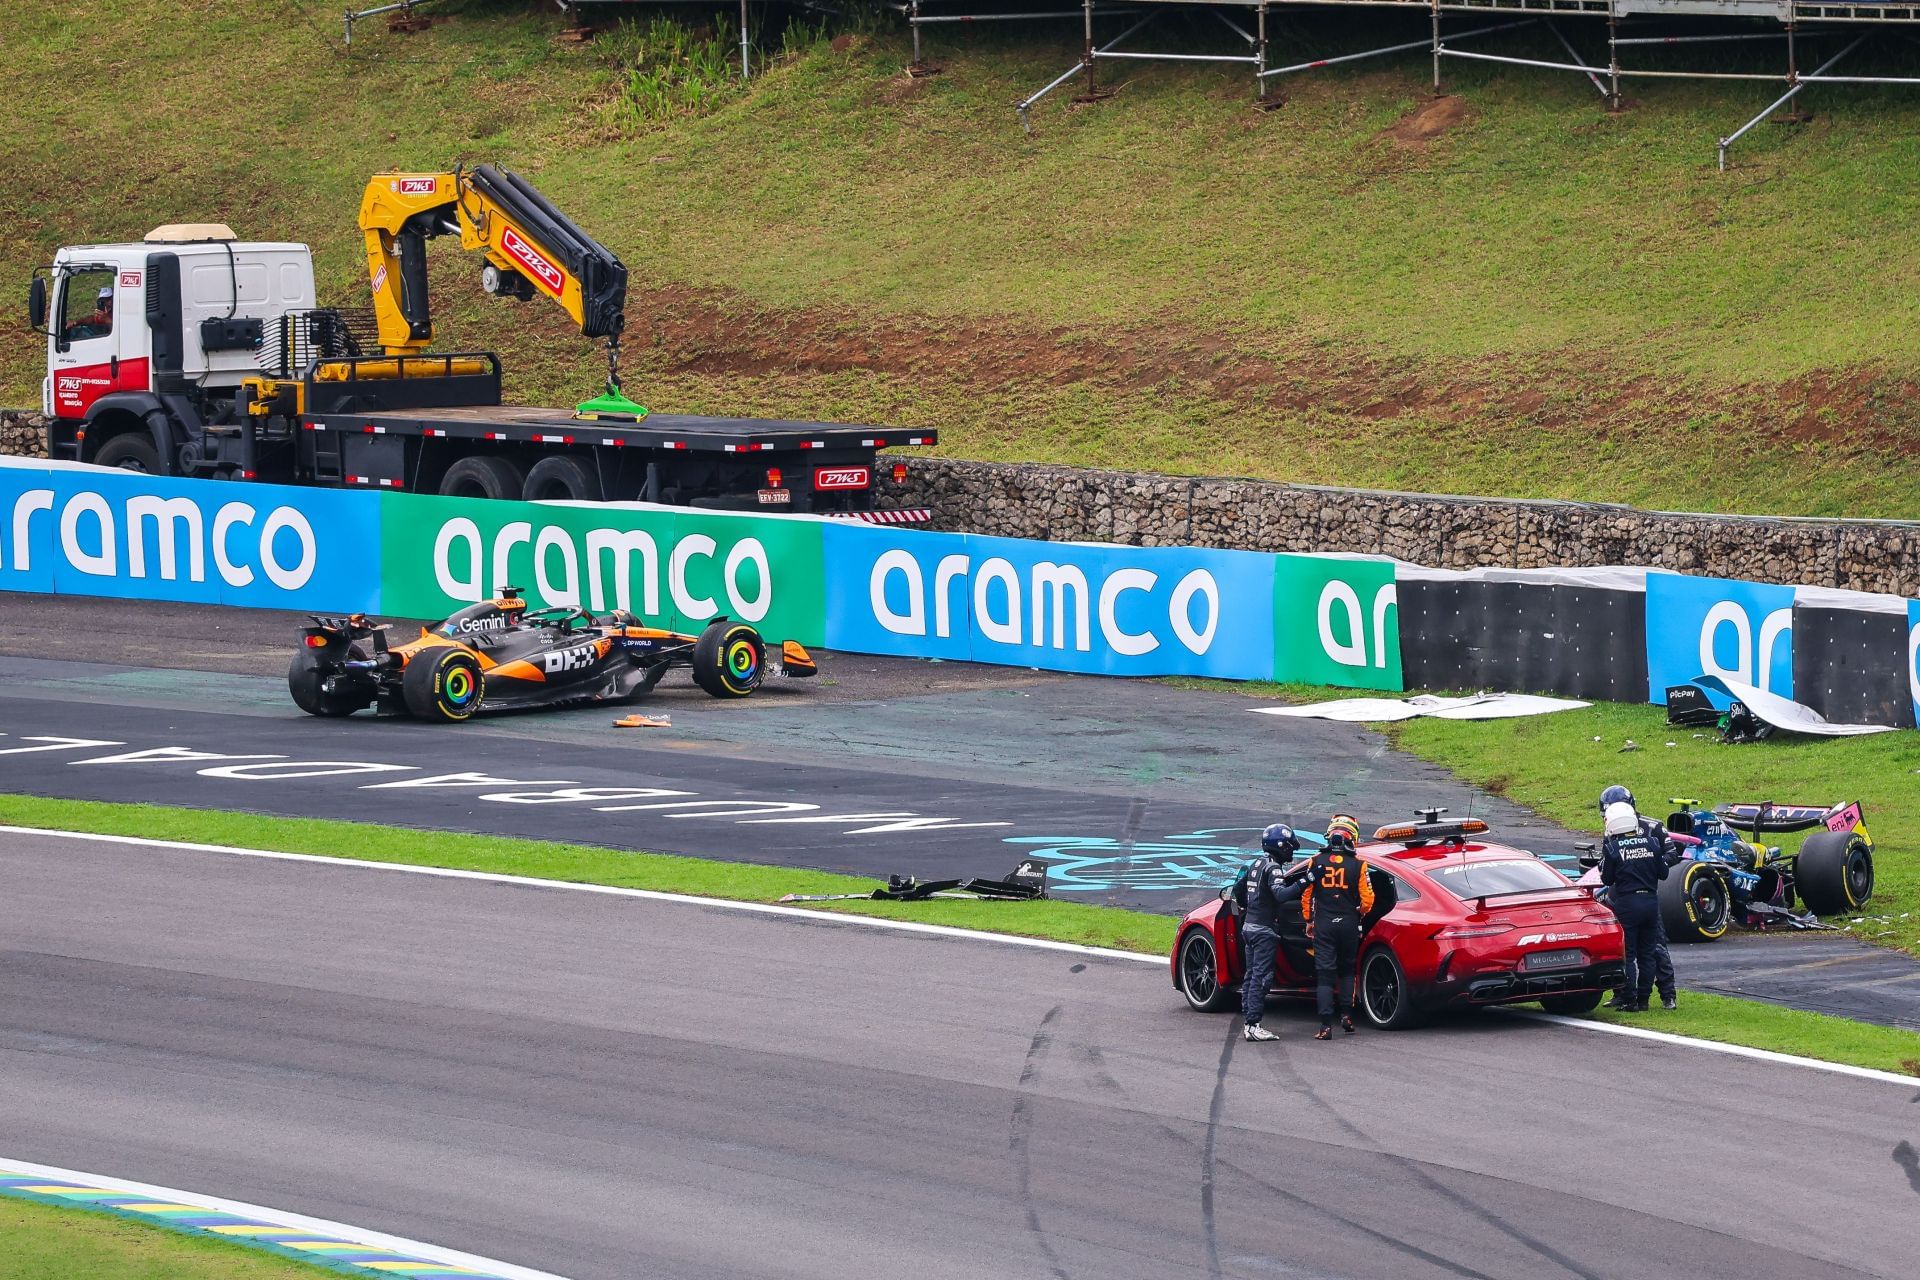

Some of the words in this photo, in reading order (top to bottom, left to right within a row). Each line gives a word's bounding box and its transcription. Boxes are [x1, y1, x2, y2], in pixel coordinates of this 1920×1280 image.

[405, 181, 431, 191] PWS
[511, 240, 556, 278] PWS
[59, 379, 81, 390] PWS
[825, 472, 862, 484] PWS
[0, 489, 318, 590] ramco
[433, 517, 773, 622] aramco
[869, 548, 1220, 657] aramco
[460, 612, 506, 633] Gemini
[1669, 690, 1696, 699] PicPay
[0, 732, 1018, 836] MUBADAL
[1831, 815, 1845, 832] eni
[1618, 837, 1649, 846] DOCTOR
[1625, 851, 1654, 860] MAGGIORE
[1532, 954, 1561, 964] MEDICAL
[1562, 953, 1576, 961] CAR
